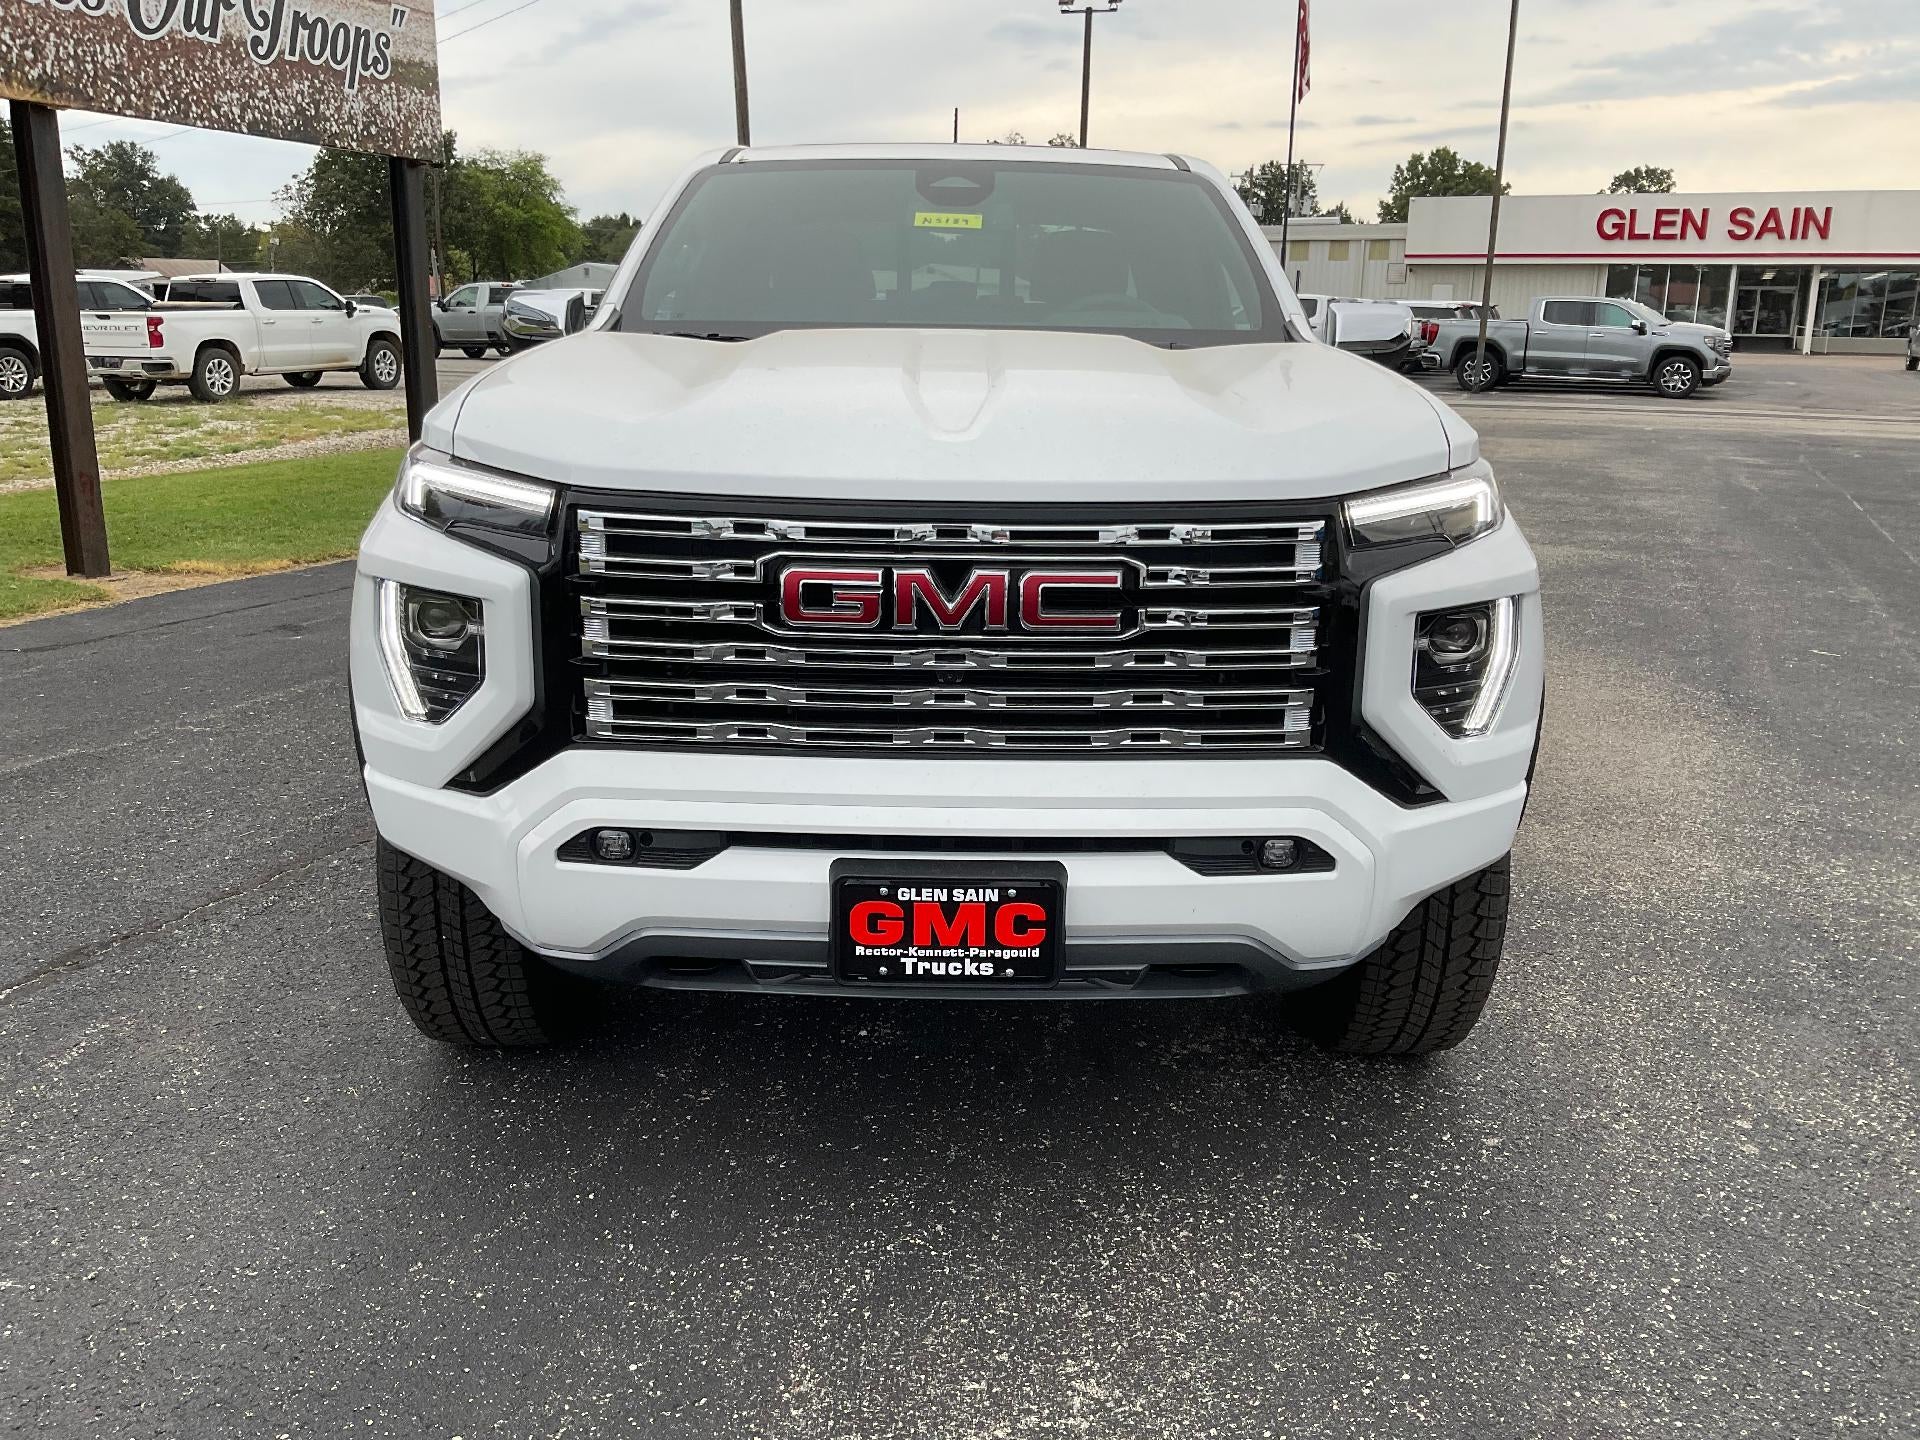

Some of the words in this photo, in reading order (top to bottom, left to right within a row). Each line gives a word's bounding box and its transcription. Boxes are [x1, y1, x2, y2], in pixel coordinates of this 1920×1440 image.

[1596, 207, 1710, 241] GLEN
[1727, 207, 1833, 241] SAIN
[780, 568, 1123, 631] GMC
[897, 887, 948, 902] GLEN
[952, 888, 999, 902] SAIN
[849, 900, 1047, 947] GMC
[900, 957, 994, 976] Trucks
